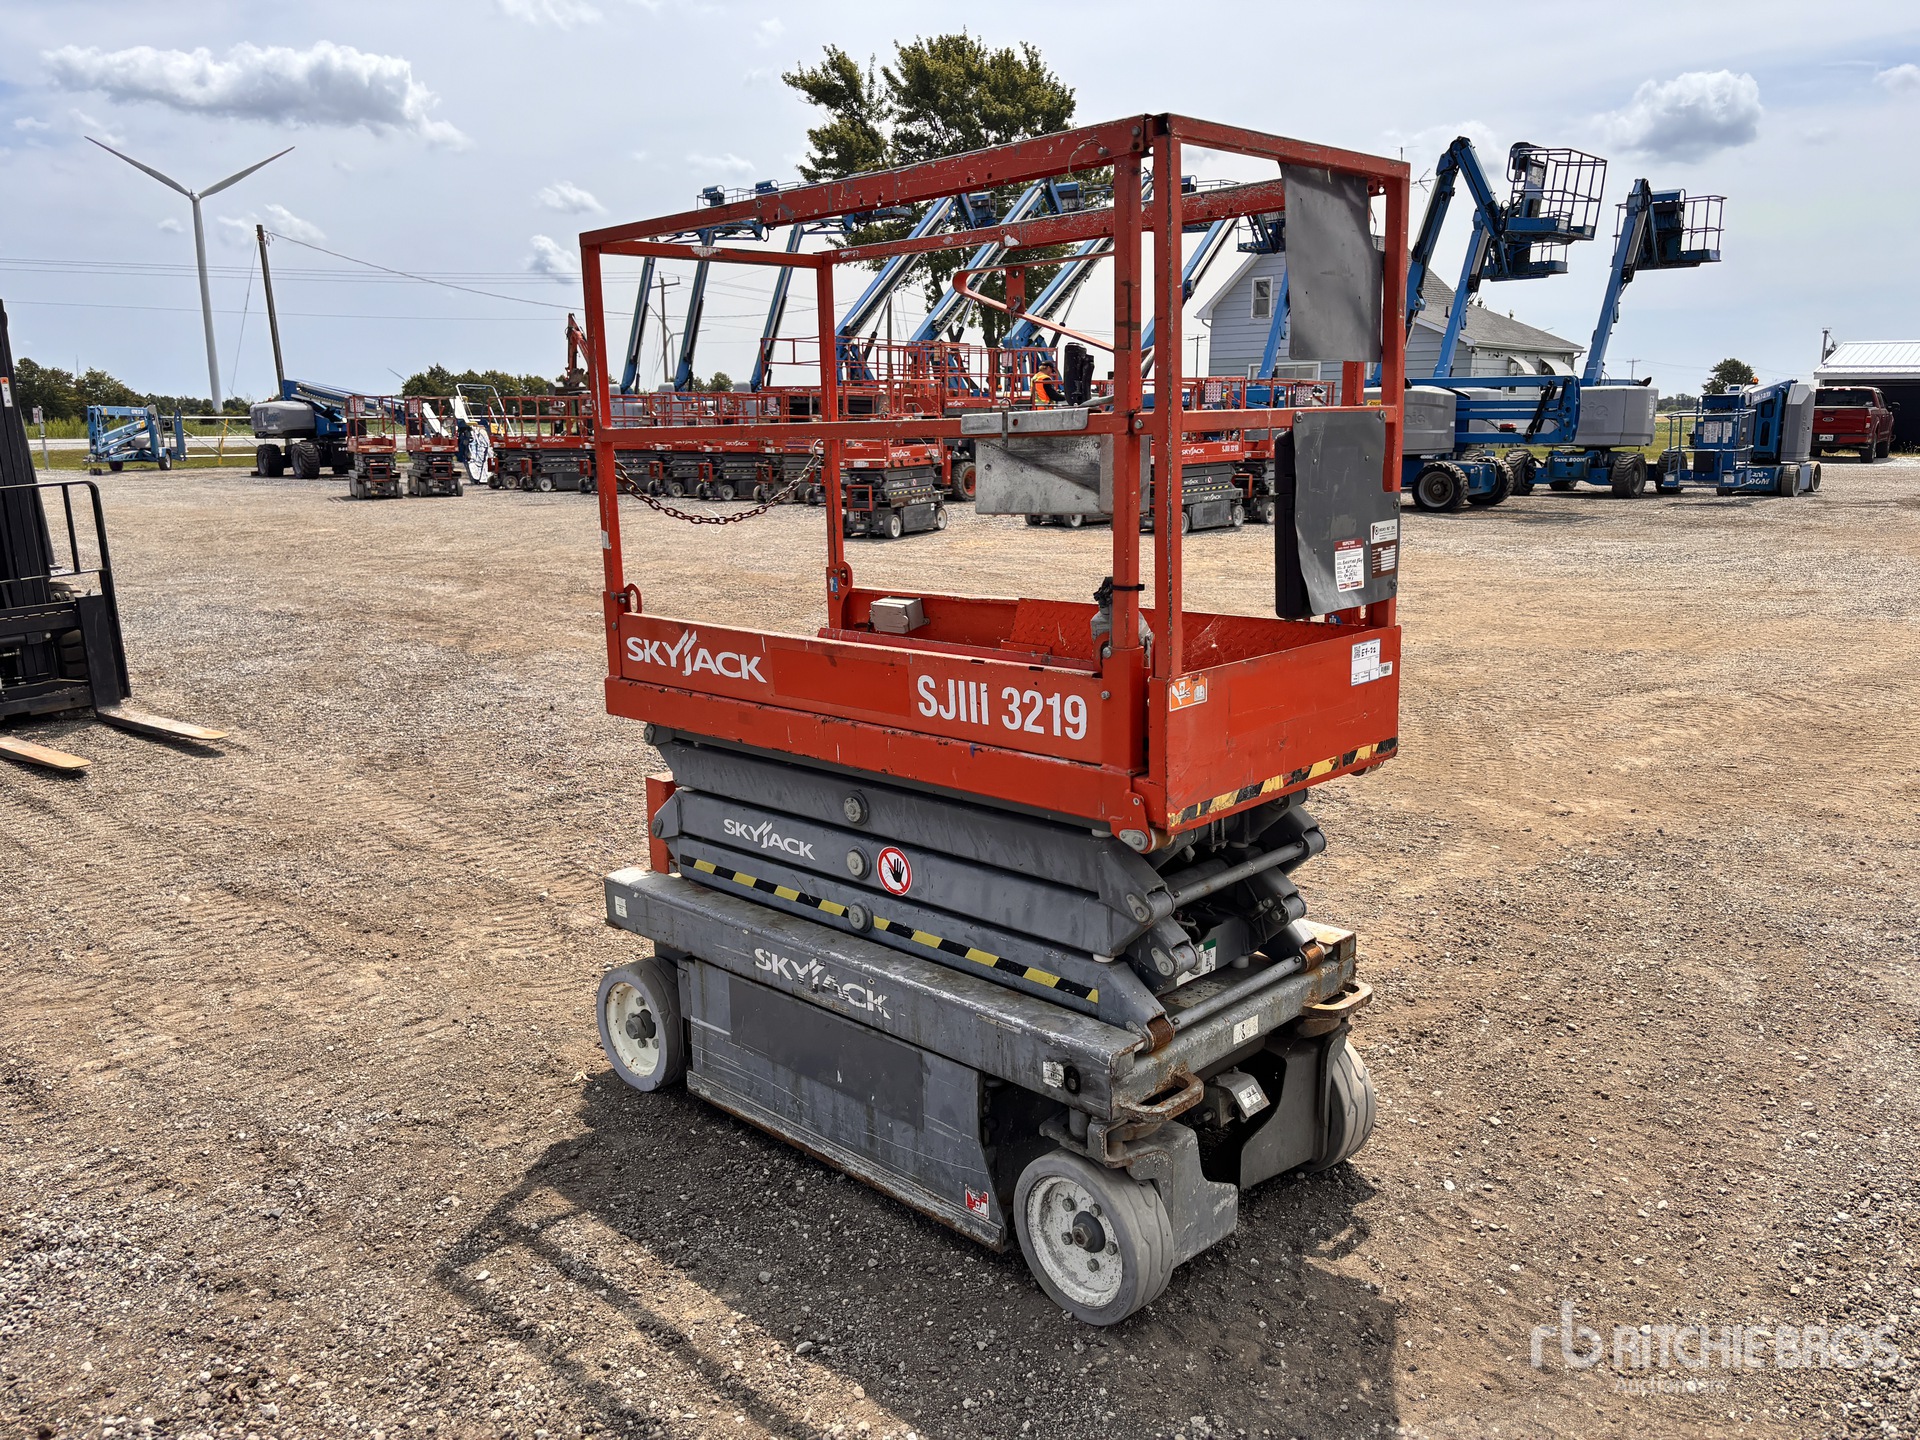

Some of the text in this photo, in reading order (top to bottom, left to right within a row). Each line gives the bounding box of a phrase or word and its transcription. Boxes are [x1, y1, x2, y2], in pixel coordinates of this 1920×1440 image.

[626, 629, 767, 683] SKYJACK
[917, 675, 1087, 740] SJIII 3219
[723, 818, 816, 861] SKYJACK
[754, 947, 891, 1020] SKYJACK
